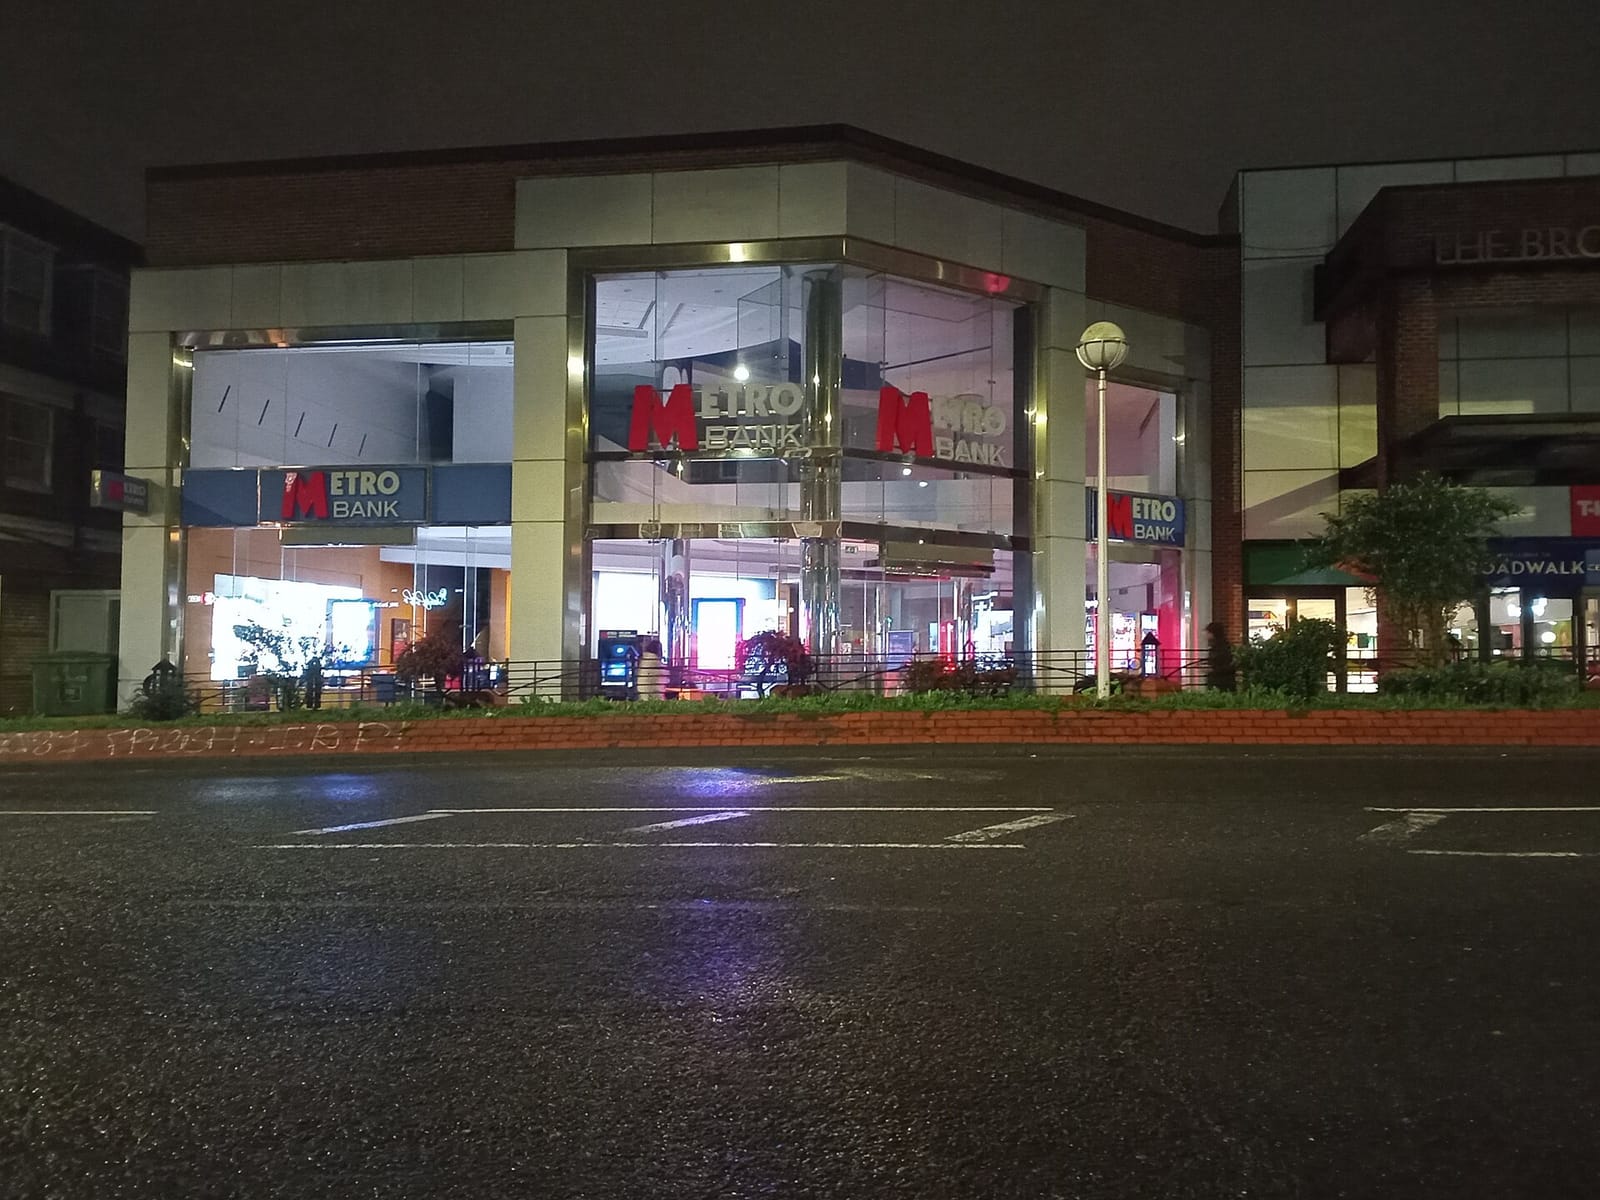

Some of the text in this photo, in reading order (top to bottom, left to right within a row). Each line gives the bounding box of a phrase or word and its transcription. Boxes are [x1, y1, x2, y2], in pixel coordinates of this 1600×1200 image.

[628, 382, 804, 452] METRO
[875, 386, 1006, 459] METRO
[705, 424, 803, 450] BANK
[935, 436, 1007, 467] BANK
[281, 471, 400, 519] METRO
[332, 501, 400, 518] BANK
[1107, 492, 1176, 538] METRO
[1133, 523, 1176, 542] BANK
[1479, 560, 1585, 576] OADWALK
